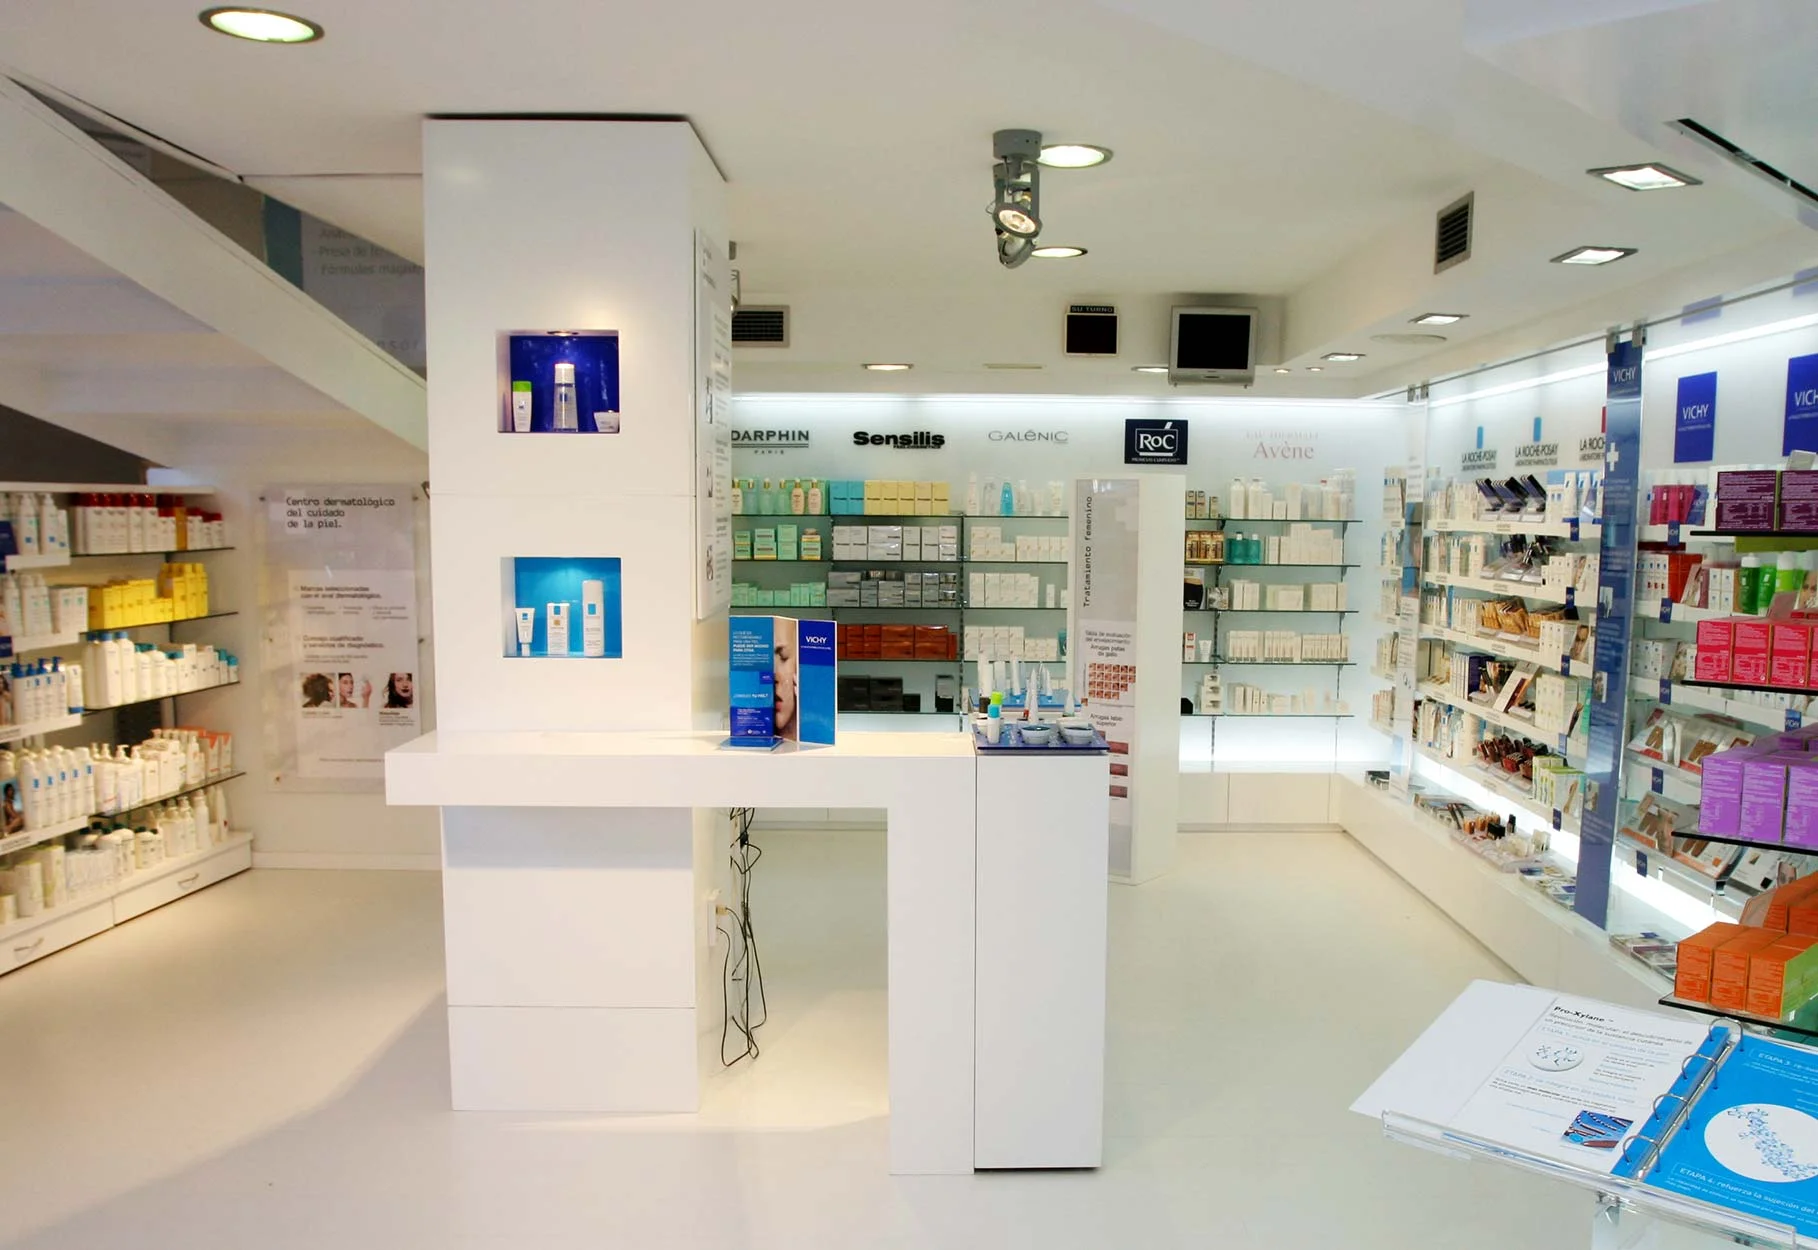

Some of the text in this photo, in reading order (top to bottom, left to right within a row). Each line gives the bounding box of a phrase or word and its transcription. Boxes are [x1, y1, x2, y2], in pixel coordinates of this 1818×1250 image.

[1613, 367, 1637, 383] VICHY
[1682, 403, 1709, 420] VICHY
[731, 430, 809, 441] DARPHIN
[853, 431, 946, 446] Sensilis
[1253, 440, 1314, 459] Avène
[1515, 443, 1558, 458] LA ROCHE-POSAY
[286, 497, 396, 509] Centro dermatológico
[286, 508, 345, 517] del cuidado
[287, 519, 299, 528] de
[303, 519, 314, 528] la
[805, 635, 827, 644] VICHY
[1680, 1167, 1706, 1181] ETAPA
